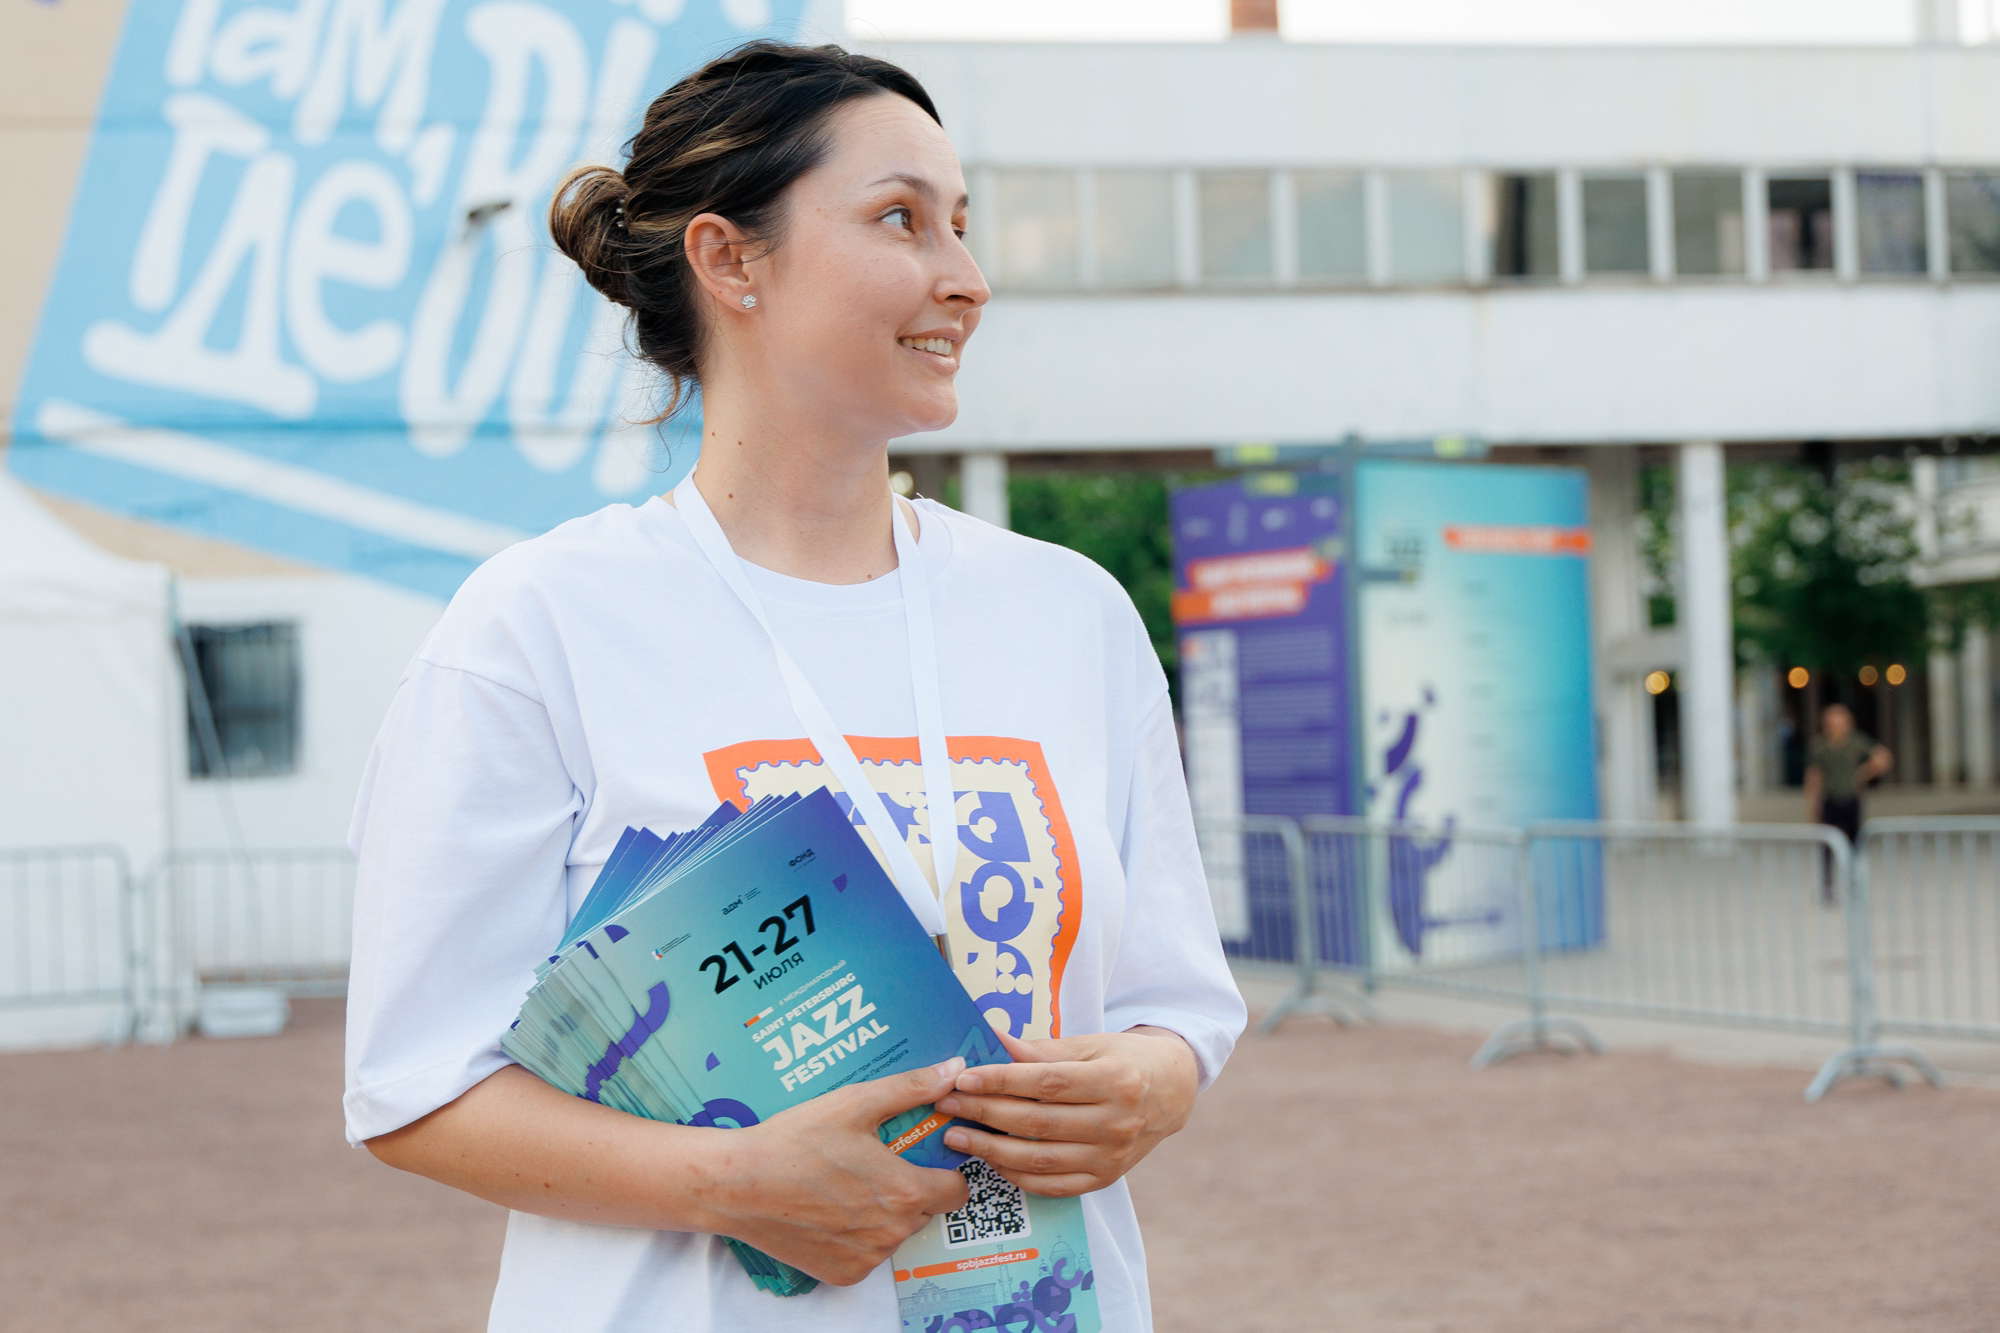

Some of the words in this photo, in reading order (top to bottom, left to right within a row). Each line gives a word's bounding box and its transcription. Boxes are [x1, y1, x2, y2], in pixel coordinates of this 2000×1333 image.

[699, 894, 816, 995] 21-27
[753, 951, 805, 990] ИЮЛЯ
[752, 1017, 785, 1043] SAINT
[785, 972, 857, 1022] PETERSBURG
[762, 984, 877, 1071] JAZZ
[779, 1018, 890, 1092] FESTIVAL
[956, 1250, 1027, 1272] spbjazzfest.ru
